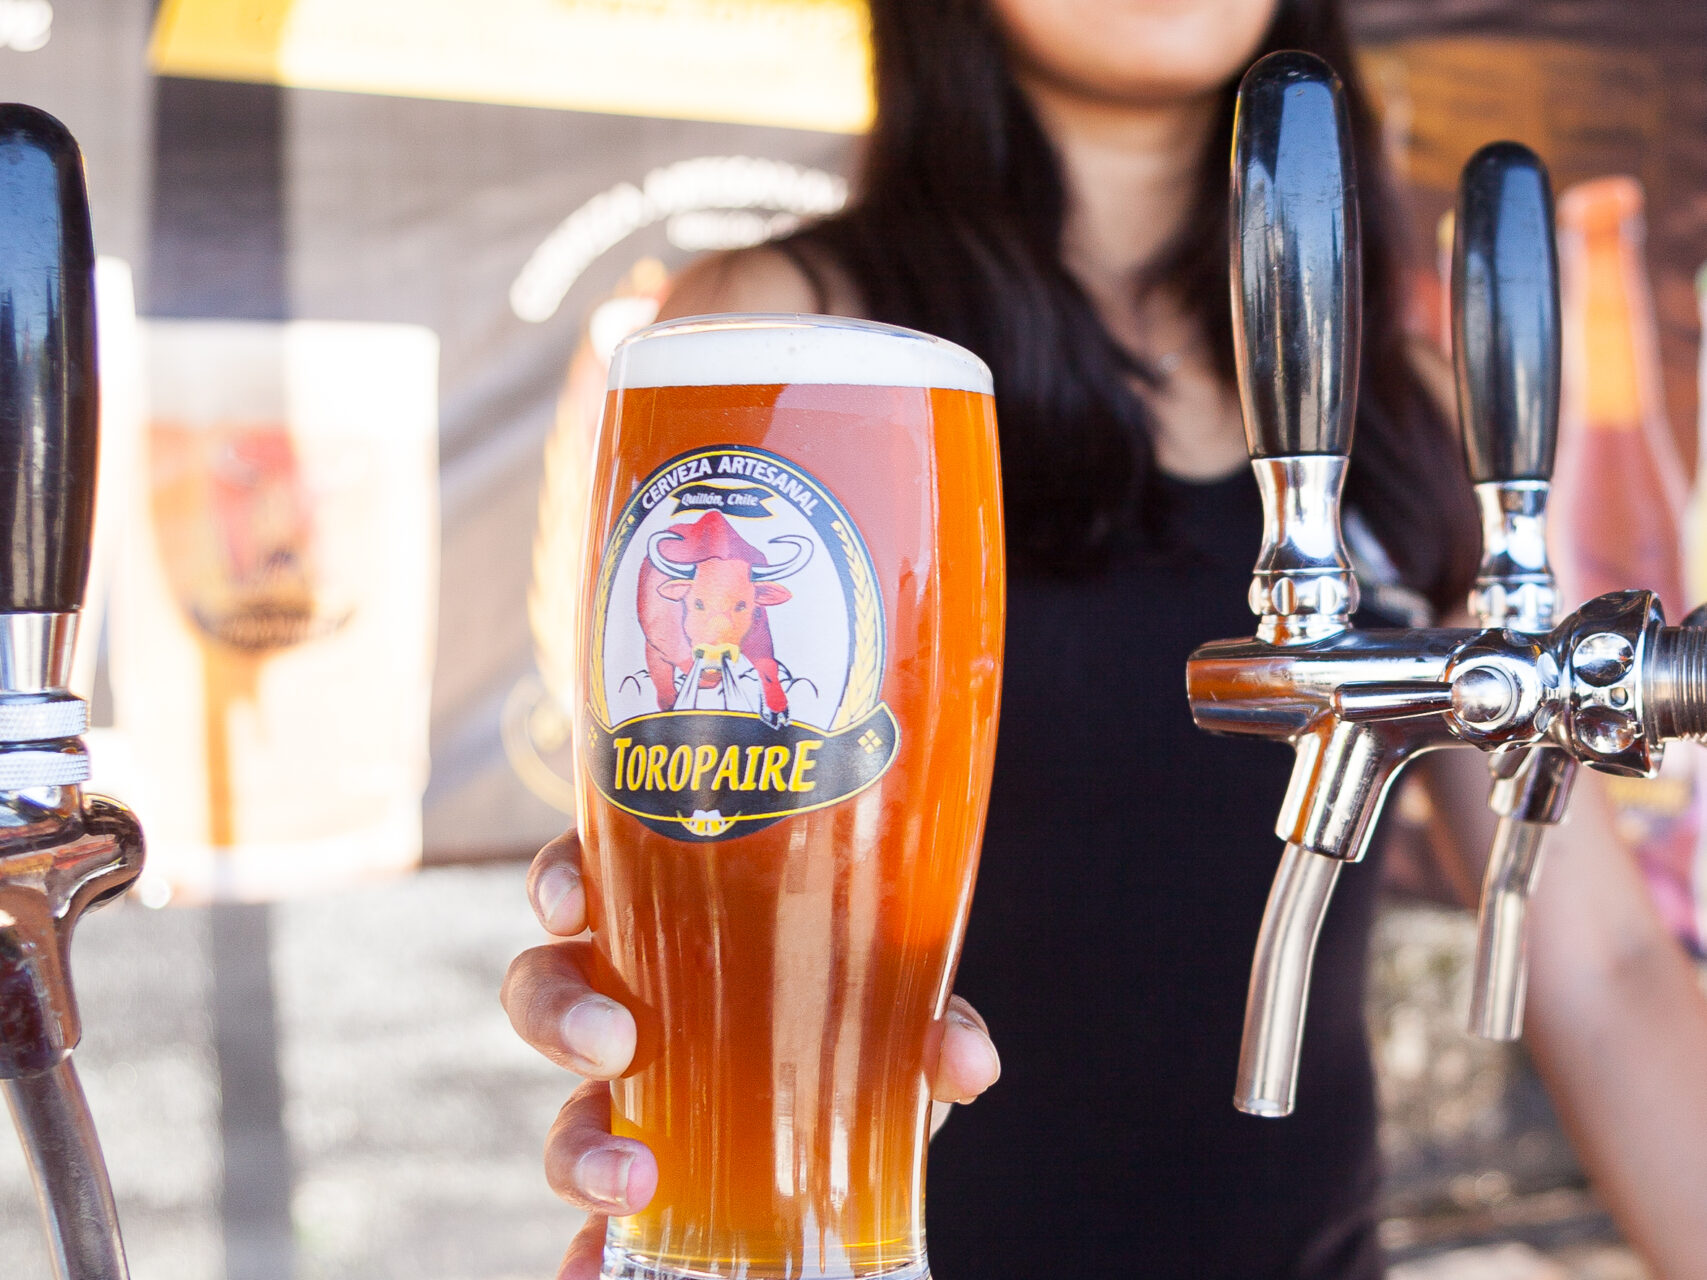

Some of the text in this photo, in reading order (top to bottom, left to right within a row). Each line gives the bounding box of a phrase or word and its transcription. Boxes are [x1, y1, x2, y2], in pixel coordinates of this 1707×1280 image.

[641, 455, 819, 517] CERVEZA ARTESANAL
[726, 492, 760, 507] Chile
[612, 736, 825, 793] TOROPAIRE
